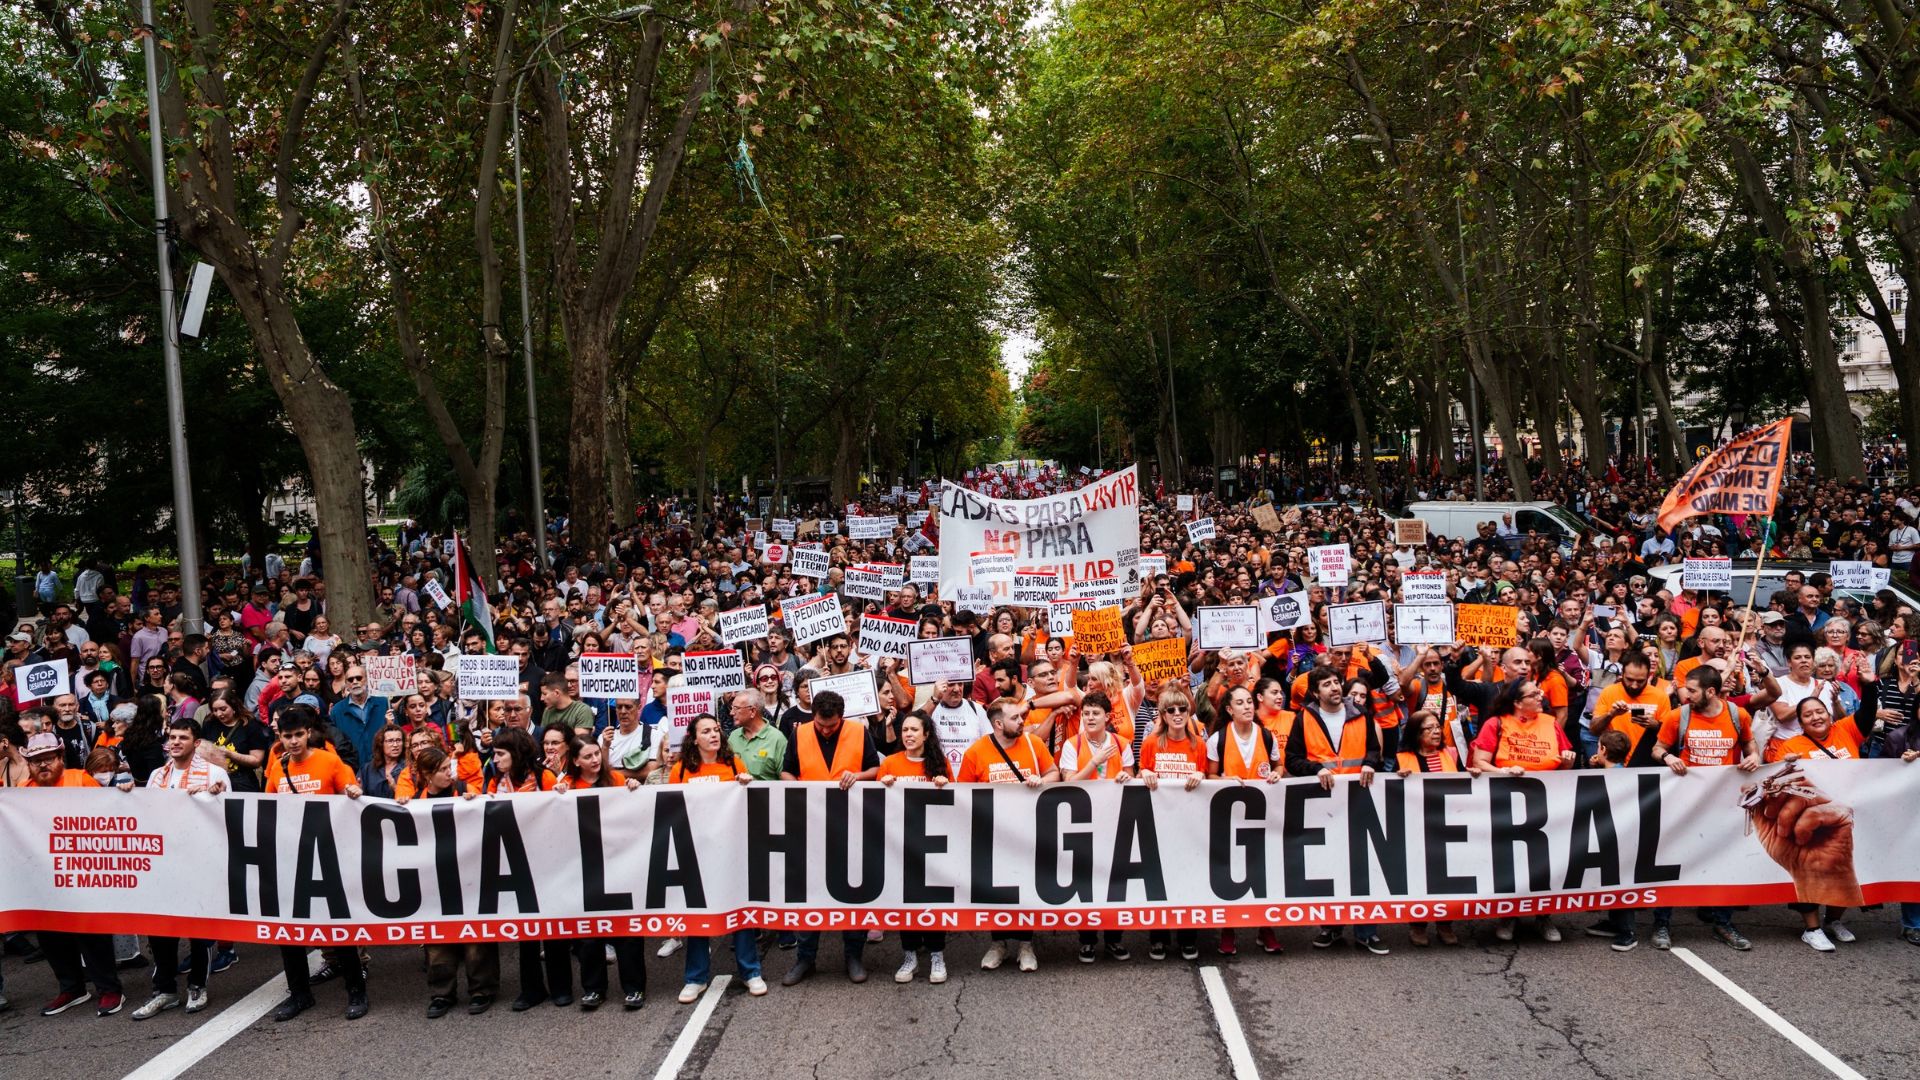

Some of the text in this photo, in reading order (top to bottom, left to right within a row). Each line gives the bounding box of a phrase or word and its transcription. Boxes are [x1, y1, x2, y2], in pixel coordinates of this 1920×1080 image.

[941, 484, 1020, 526] CASAS
[1025, 496, 1083, 529] PARA
[983, 521, 1094, 560] NO PARA
[795, 550, 828, 564] DERECHO
[793, 560, 827, 572] A TECHO
[883, 566, 903, 576] FRAUDE
[846, 571, 855, 581] NO
[861, 573, 883, 584] FRAUDE
[1014, 576, 1059, 587] NO al FRAUDE
[1091, 578, 1118, 587] VENDEN
[956, 587, 992, 601] Nos multan
[1013, 591, 1058, 601] HIPOTECARIO!
[1079, 588, 1116, 598] PRISIONES
[793, 598, 836, 626] ¡PEDIMOS
[1050, 601, 1097, 618] ¡PEDIMOS
[1272, 602, 1298, 614] STOP
[721, 607, 766, 627] NO al FRAUDE
[1273, 610, 1301, 622] DESAHUCIOS
[1459, 615, 1483, 625] VUELVE
[724, 622, 768, 640] HIPOTECARIO!
[794, 628, 808, 641] LO
[809, 615, 844, 637] JUSTO!
[861, 618, 916, 638] ACAMPADA
[1050, 621, 1063, 633] LO
[1458, 623, 1509, 636] ESTAS CASAS
[1073, 630, 1119, 643] SEREMOS TU
[1459, 633, 1515, 647] SON NUESTRAS
[860, 636, 881, 652] PRO
[883, 640, 907, 655] CAS
[480, 659, 489, 671] SU
[489, 659, 518, 671] BURBUJA
[581, 658, 636, 673] NO al FRAUDE
[684, 654, 742, 672] NO al FRAUDE
[28, 669, 55, 683] STOP
[368, 667, 415, 680] HAY QUIEN
[28, 678, 57, 691] DESAHUCIOS
[481, 675, 492, 687] QUE
[581, 678, 637, 693] HIPOTECARIO!
[671, 691, 712, 704] POR UNA
[675, 703, 709, 715] HUELGA
[1688, 729, 1722, 738] SINDICATO
[1689, 738, 1734, 748] DE INQUILINAS
[1154, 752, 1188, 761] SINDICATO
[990, 773, 998, 781] DE
[53, 816, 138, 831] SINDICATO
[53, 836, 161, 853] DE INQUILINAS
[224, 773, 1682, 920] HACIA LA HUELGA GENERAL
[53, 856, 152, 872] E INQUILINOS
[54, 873, 138, 888] DE MADRID
[256, 888, 1658, 943] BAJADA DEL ALQUILER 50% EXPROPIACIÓN FONDOS BUITRE CONTRATOS INDEFINIDOS
